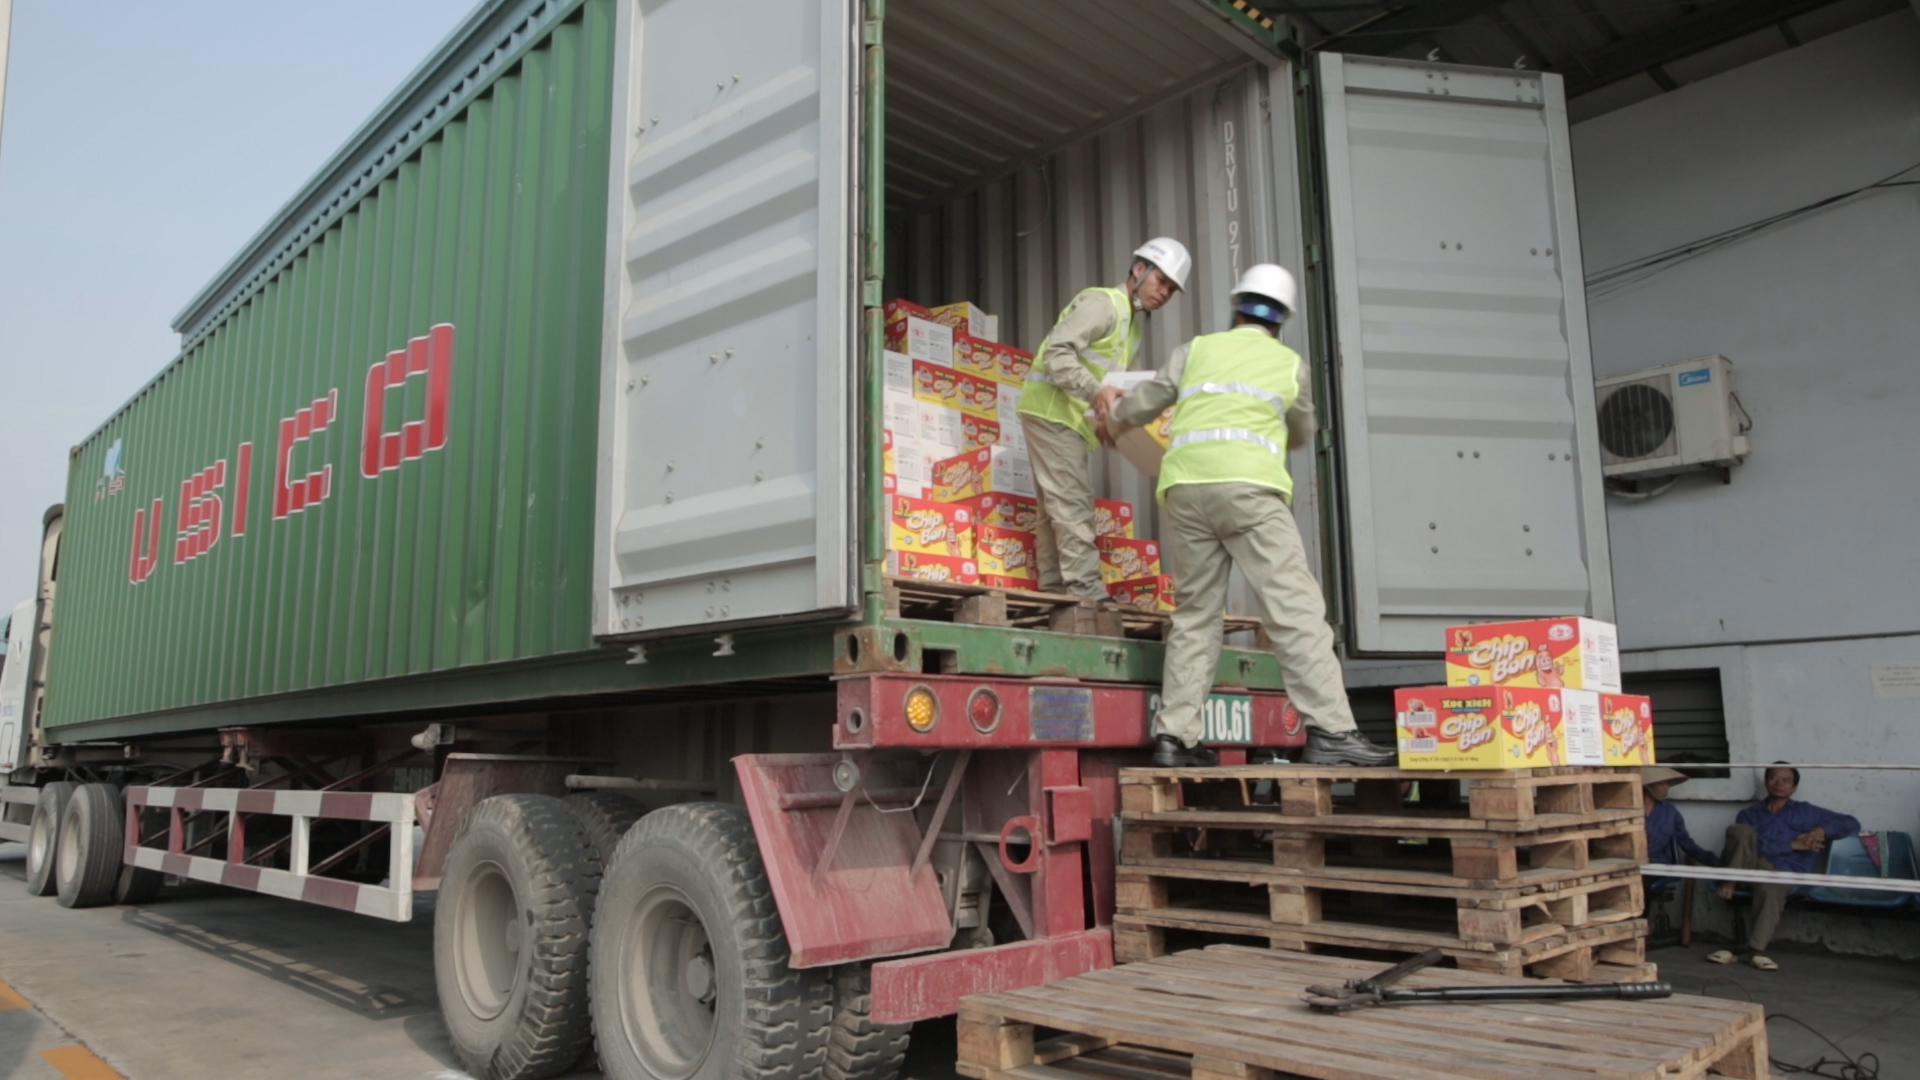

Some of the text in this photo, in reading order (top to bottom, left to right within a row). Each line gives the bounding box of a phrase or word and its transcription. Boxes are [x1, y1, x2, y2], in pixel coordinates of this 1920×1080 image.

[1223, 120, 1238, 212] DRYU
[908, 510, 943, 529] Chip
[920, 526, 947, 545] Bon
[1472, 637, 1528, 664] Chip
[1493, 653, 1537, 683] Bon
[1442, 714, 1488, 738] Chip
[1512, 704, 1542, 733] Chip
[1459, 728, 1495, 751] Bon
